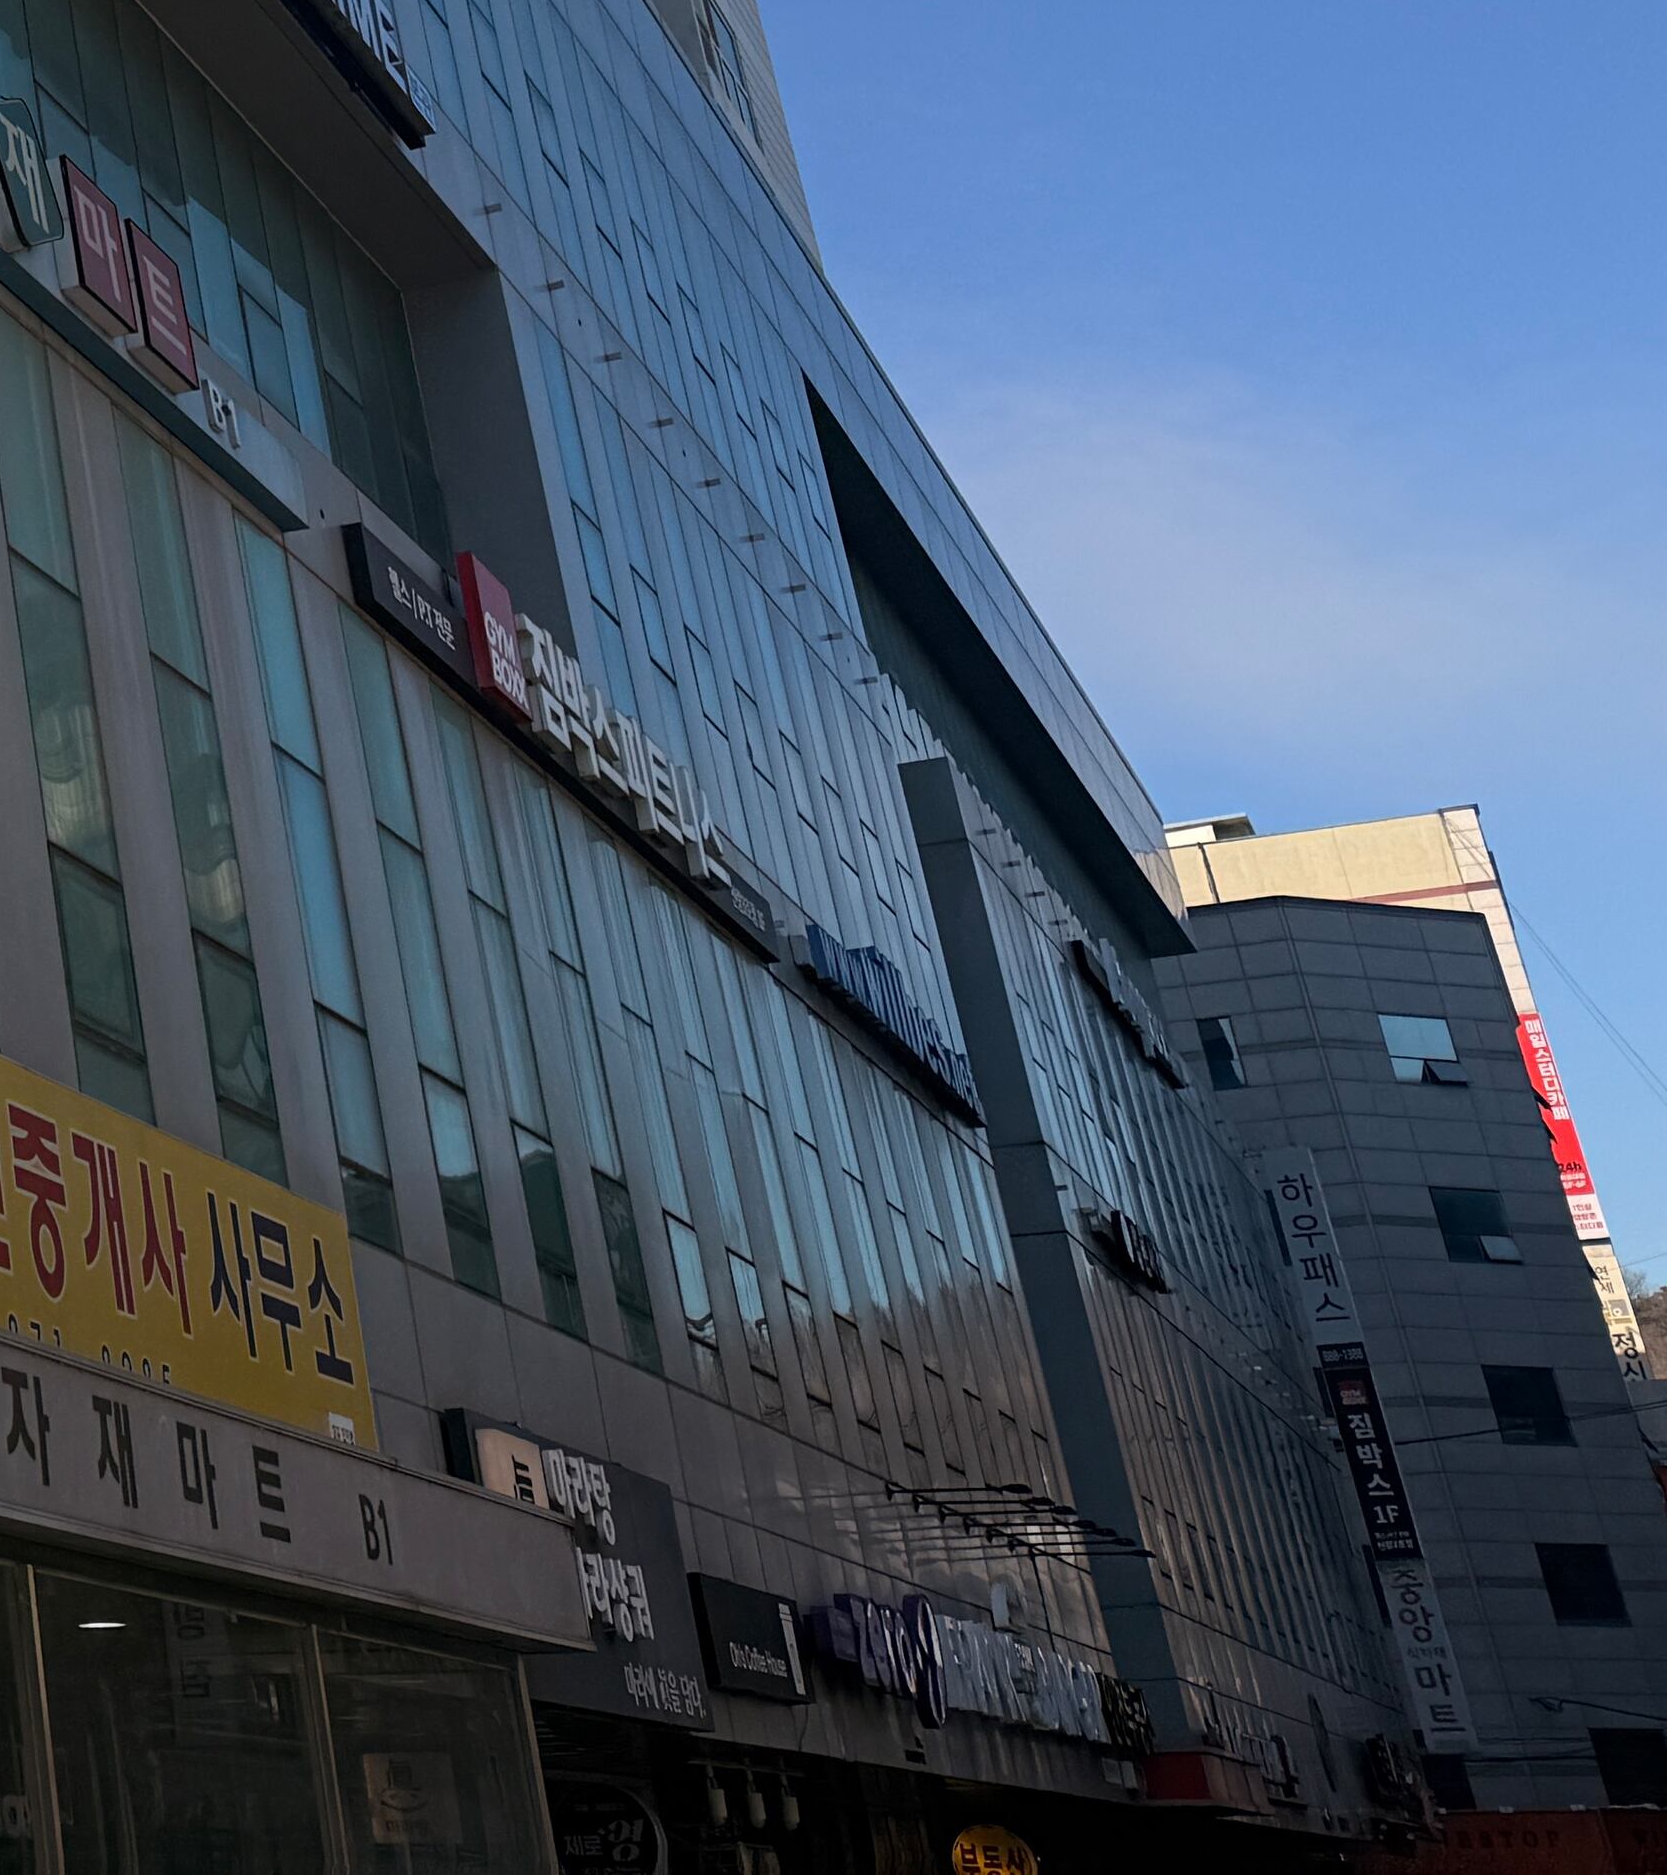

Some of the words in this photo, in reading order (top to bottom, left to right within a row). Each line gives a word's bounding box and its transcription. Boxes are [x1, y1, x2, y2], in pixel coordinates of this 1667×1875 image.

[208, 379, 240, 448] B1
[484, 611, 516, 666] GYM
[492, 647, 530, 710] BOXX
[519, 613, 733, 887] 짐박스피트니스
[1524, 1019, 1570, 1120] 매일스터디카페
[1276, 1172, 1352, 1323] 하우패스
[206, 1190, 355, 1386] 사무소
[1347, 1411, 1395, 1497] 짐박스
[361, 1493, 394, 1567] B1
[544, 1448, 617, 1546] 마라탕
[1373, 1505, 1399, 1525] 1F
[1390, 1568, 1436, 1644] 중앙
[1414, 1663, 1467, 1733] 마트
